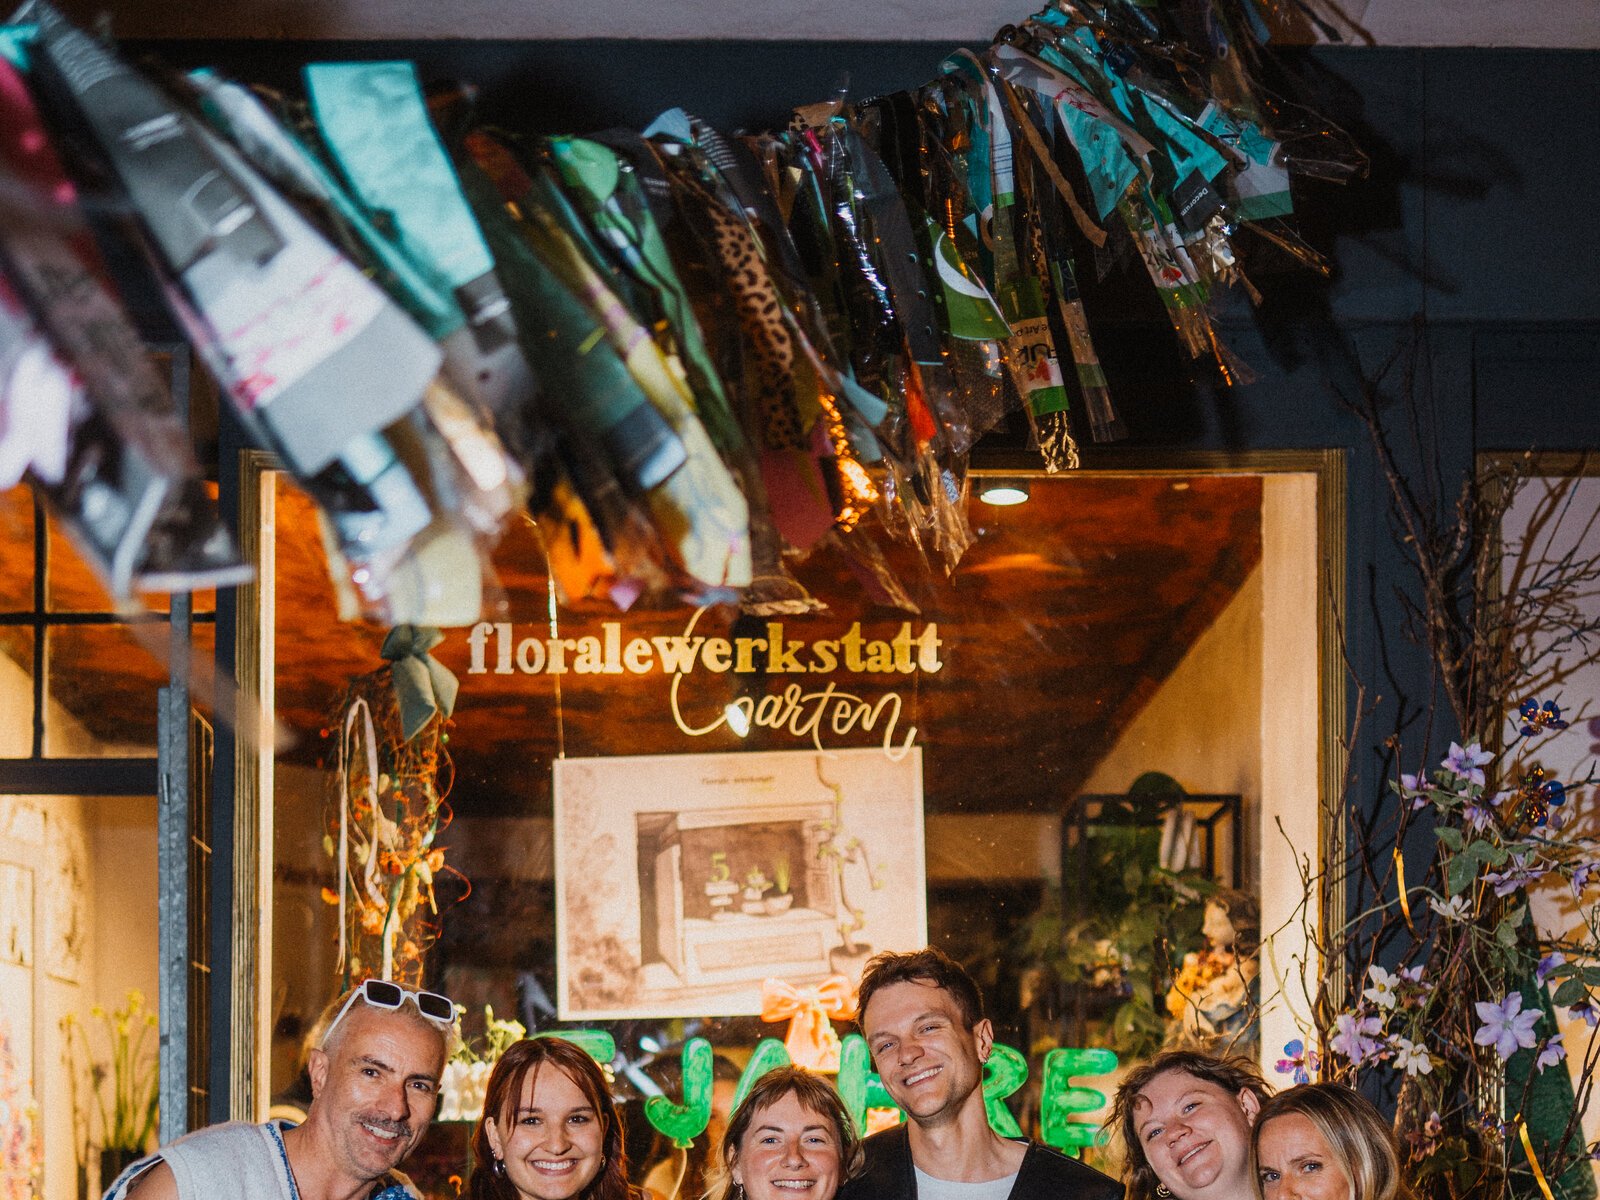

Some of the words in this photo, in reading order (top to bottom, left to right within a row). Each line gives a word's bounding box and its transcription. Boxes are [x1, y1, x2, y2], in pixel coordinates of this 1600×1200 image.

[1181, 187, 1209, 217] Decorum
[467, 621, 943, 674] floralewerkstatt
[671, 605, 918, 761] Garten
